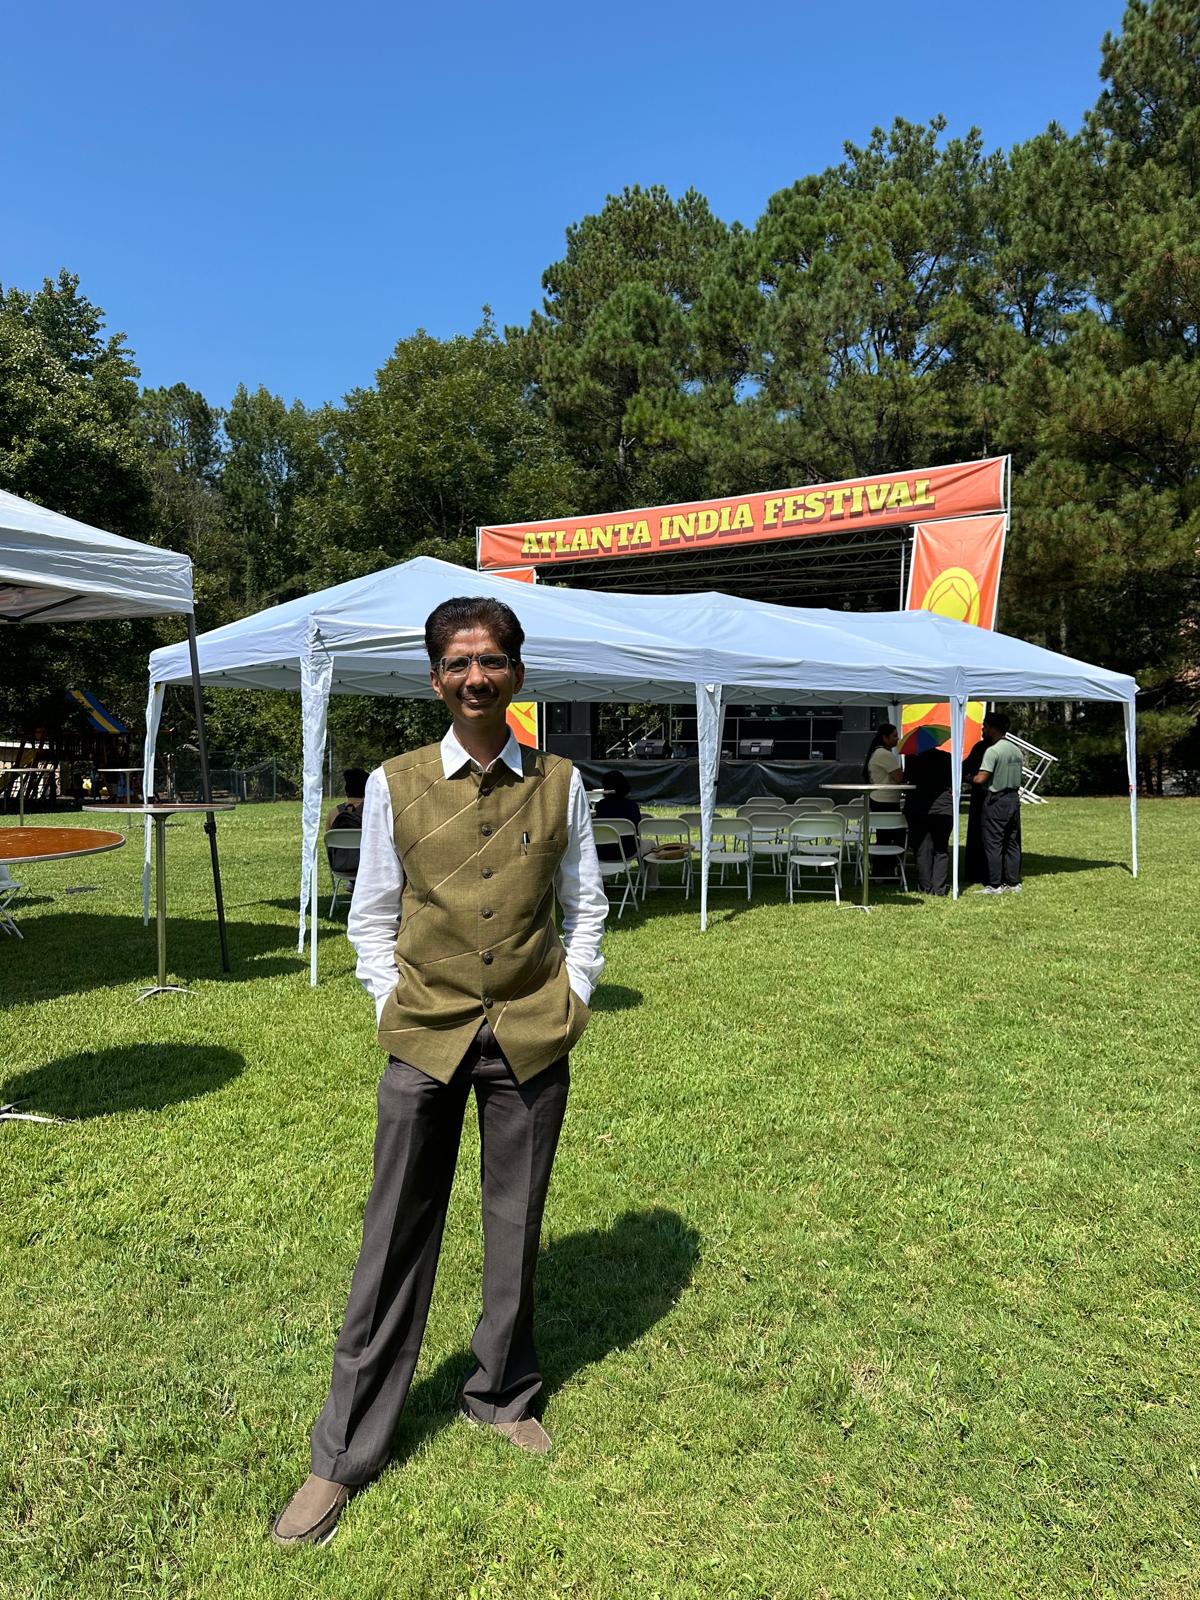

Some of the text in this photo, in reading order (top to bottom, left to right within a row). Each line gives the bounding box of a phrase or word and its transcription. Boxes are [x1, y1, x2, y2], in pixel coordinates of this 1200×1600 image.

[521, 478, 936, 558] ATLANTA INDIA FESTIVAL
